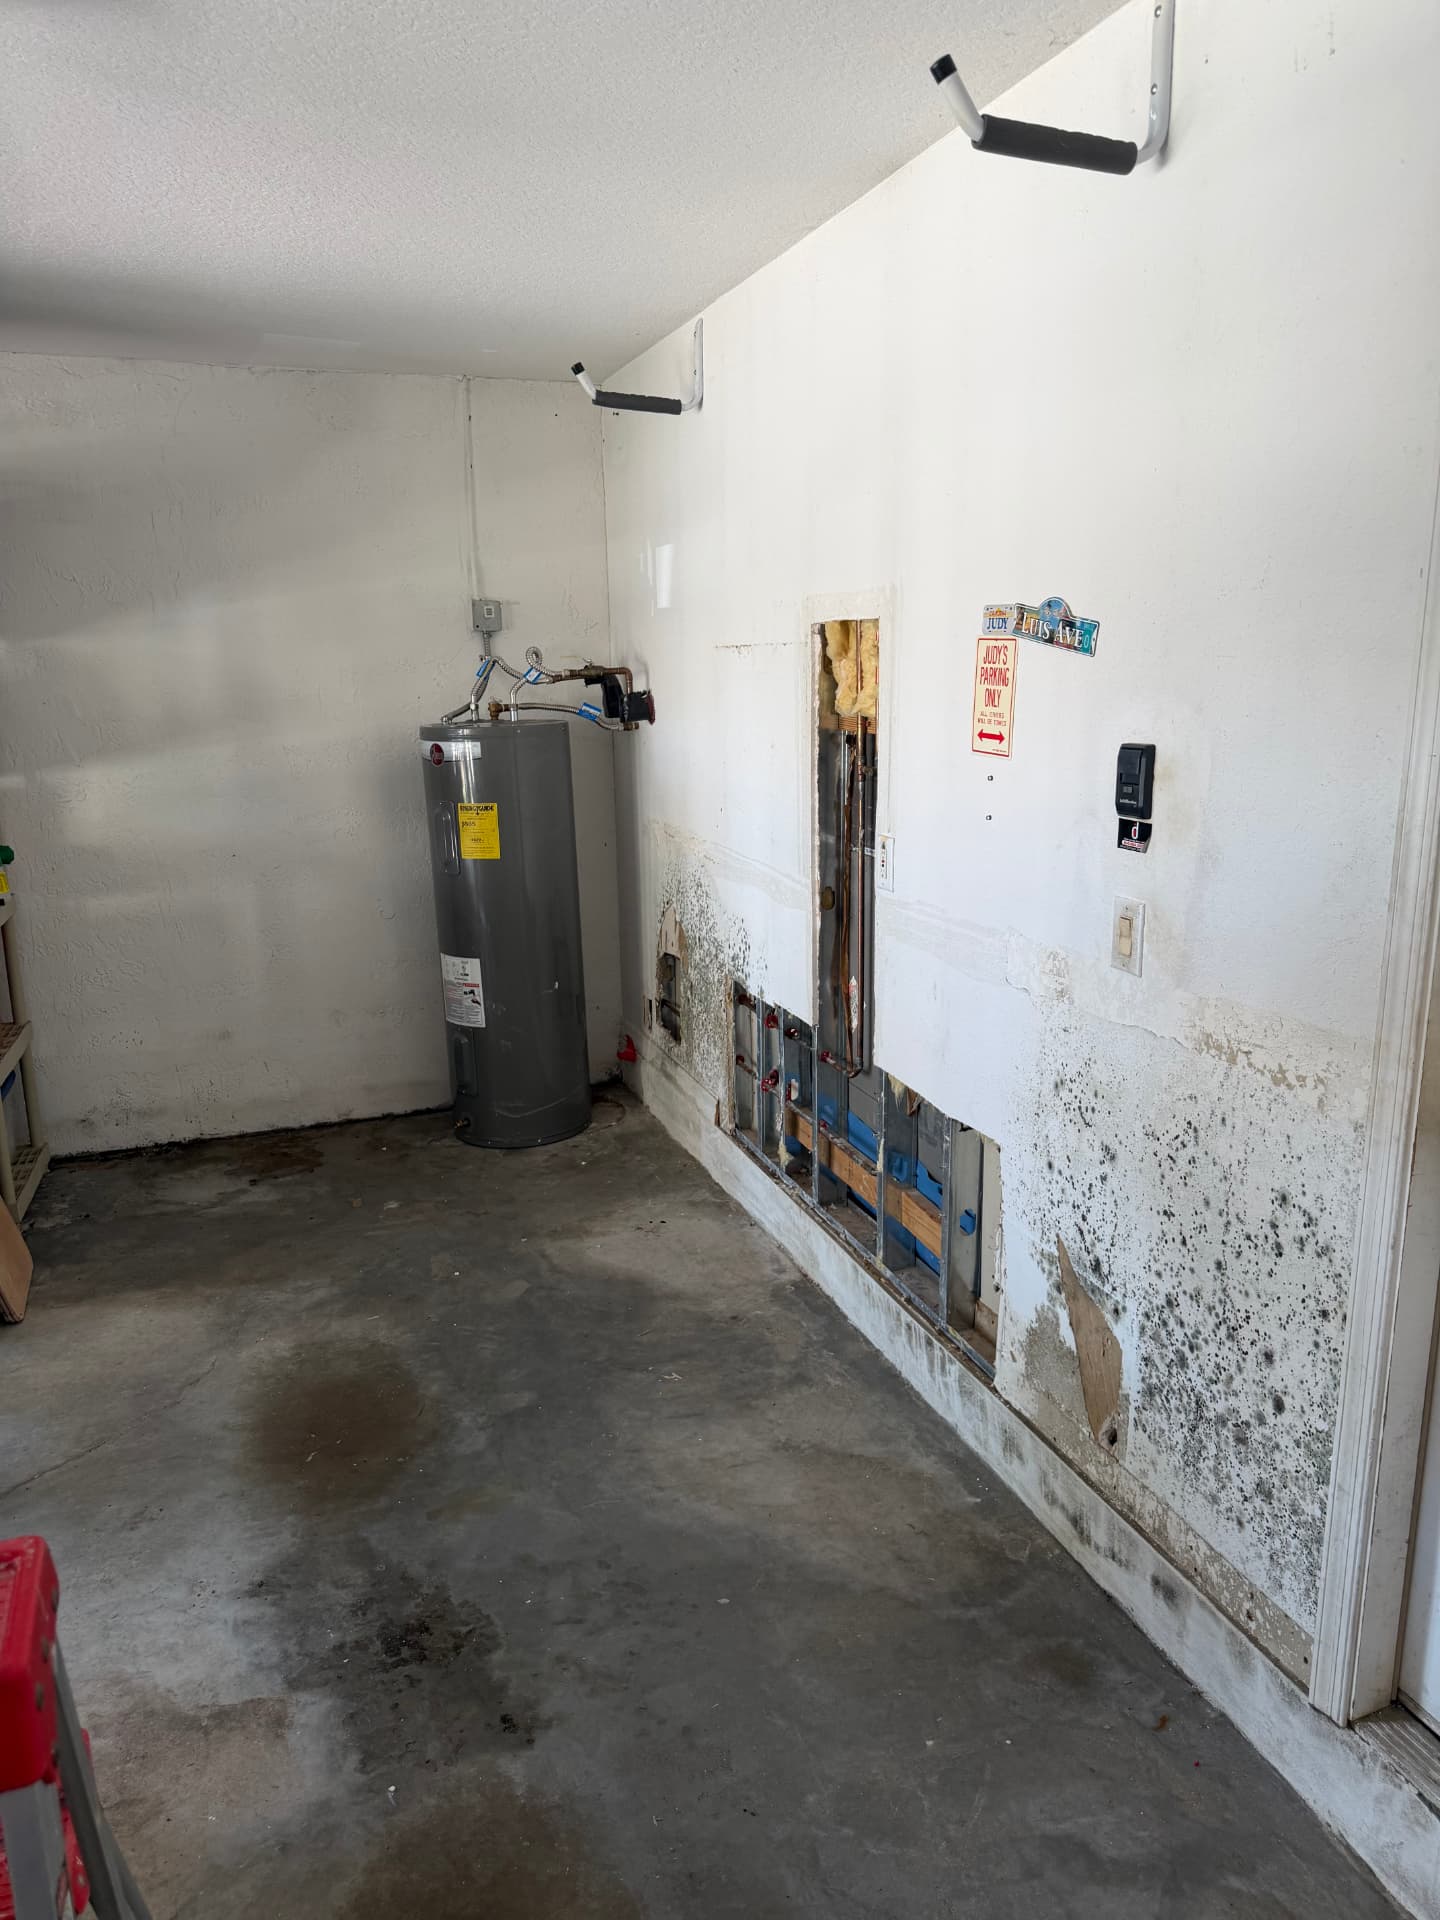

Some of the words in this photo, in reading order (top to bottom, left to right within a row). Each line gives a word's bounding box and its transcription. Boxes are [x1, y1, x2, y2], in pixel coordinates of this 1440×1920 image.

[987, 617, 1009, 630] JUDY
[1022, 612, 1051, 639] LUIS
[1054, 620, 1084, 648] AVE
[983, 644, 1009, 665] JUDY'S
[980, 666, 1010, 687] PARKING
[984, 688, 1002, 708] ONLY
